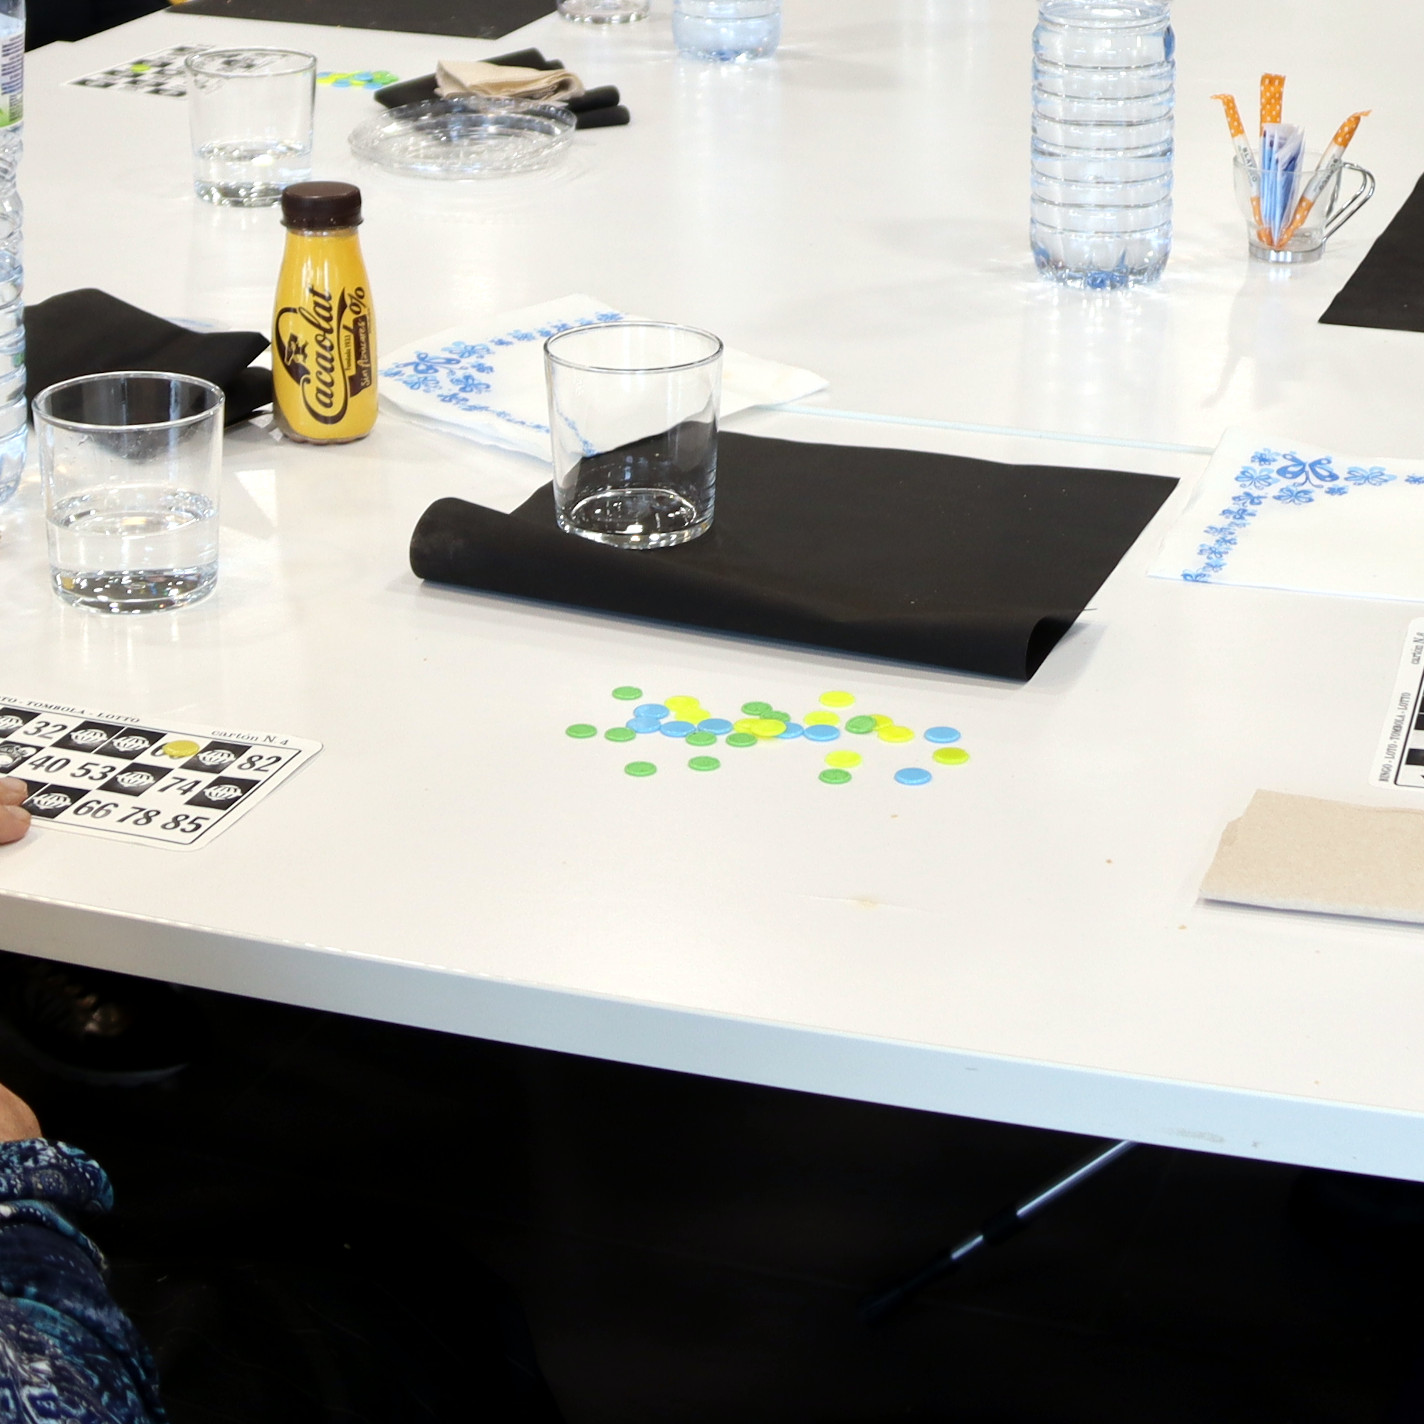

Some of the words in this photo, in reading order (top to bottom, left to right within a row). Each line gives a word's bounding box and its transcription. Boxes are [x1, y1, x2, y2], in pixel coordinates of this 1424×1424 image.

[347, 286, 367, 315] 0%
[297, 285, 349, 425] Cacaolat
[360, 370, 371, 386] Sin
[26, 700, 87, 716] TOMBOLA
[97, 712, 141, 724] LOTTO
[23, 720, 68, 740] 32
[236, 754, 283, 773] 82
[29, 754, 71, 774] 40
[70, 761, 117, 782] 53
[157, 776, 203, 796] 74
[72, 799, 119, 819] 66
[116, 806, 162, 826] 78
[160, 813, 211, 834] 85
